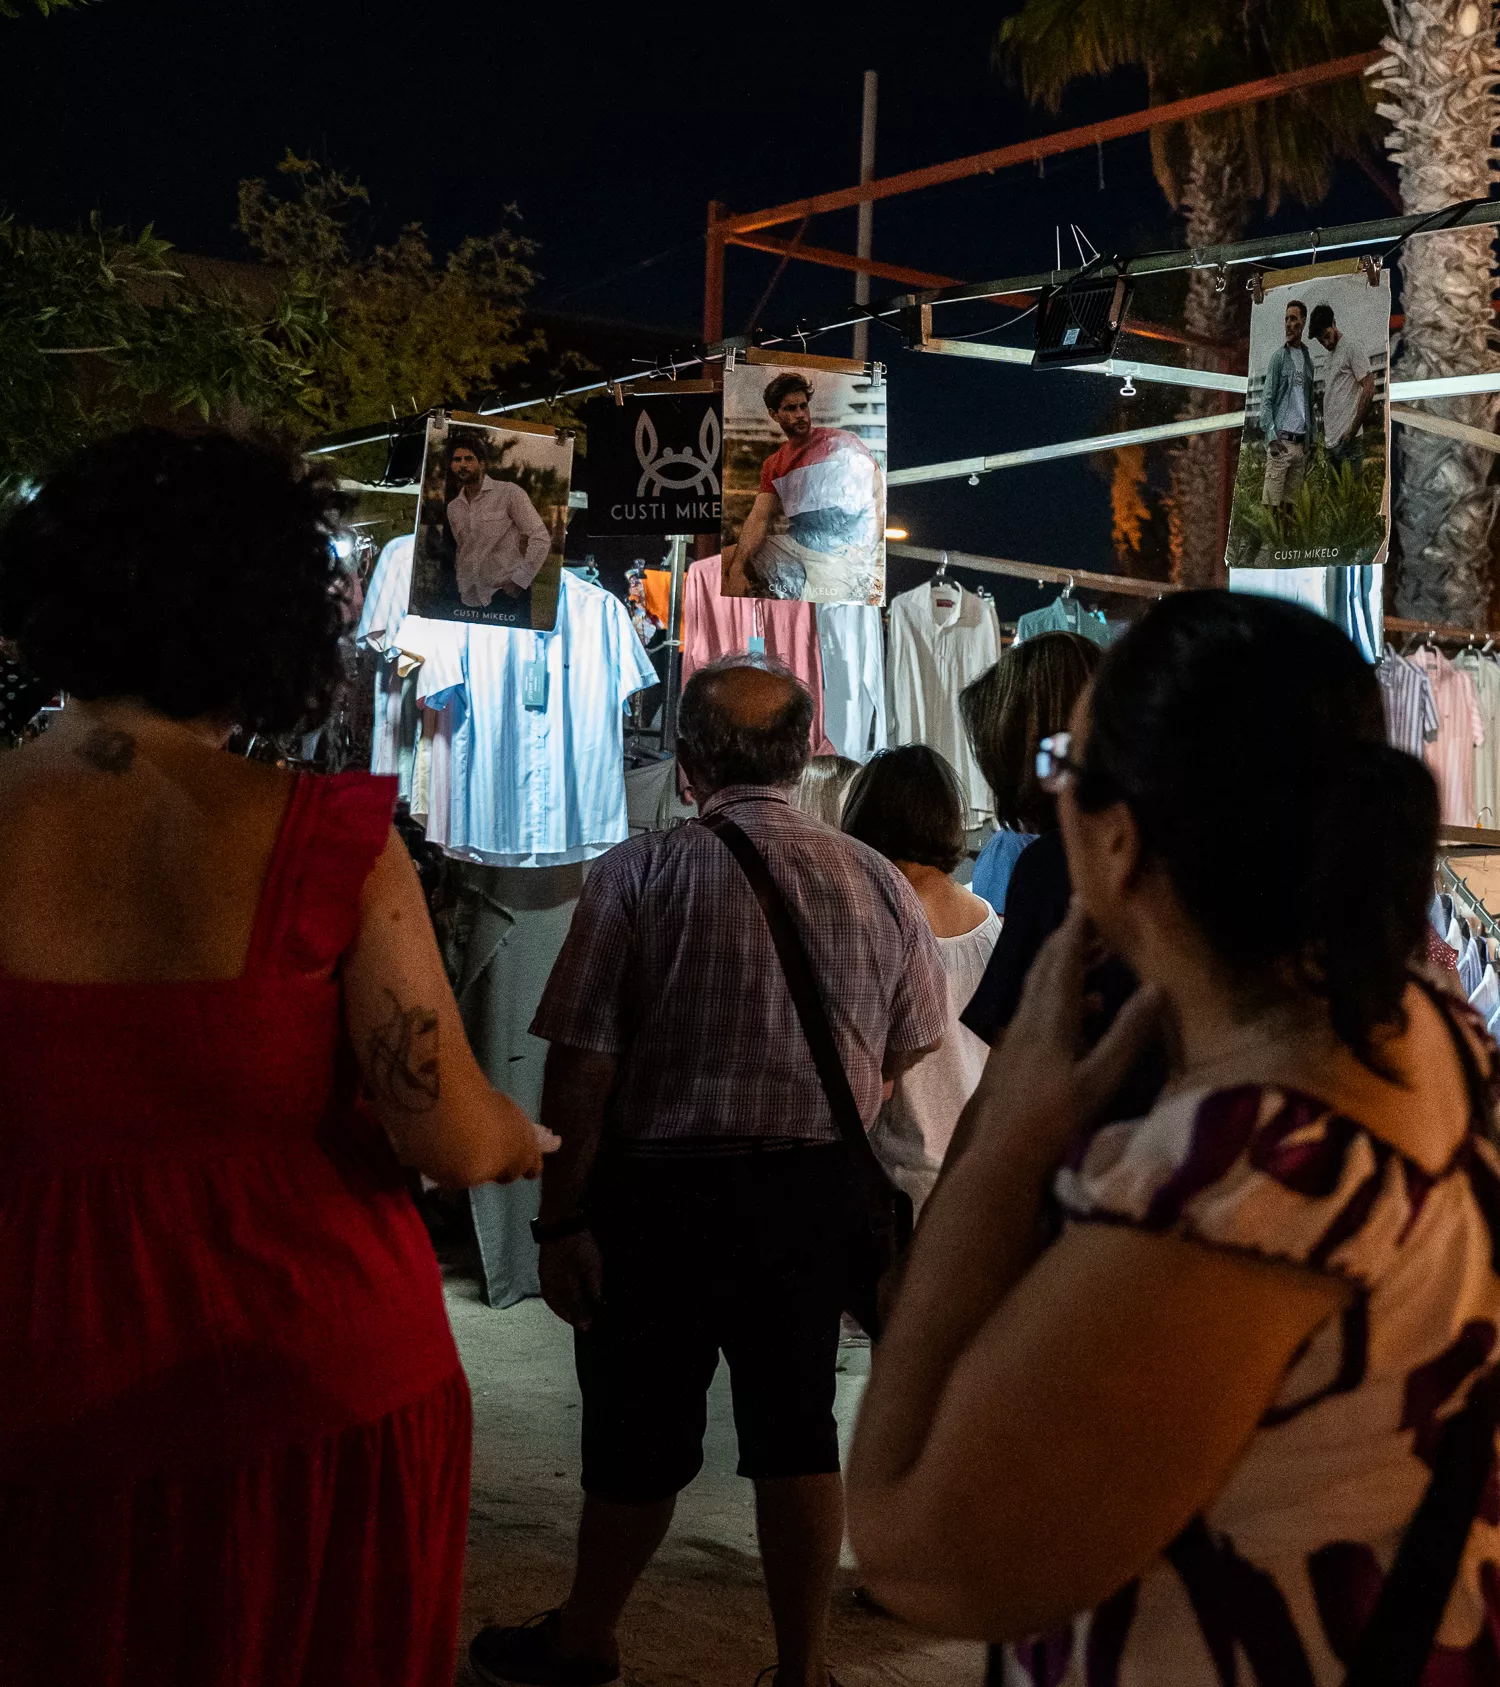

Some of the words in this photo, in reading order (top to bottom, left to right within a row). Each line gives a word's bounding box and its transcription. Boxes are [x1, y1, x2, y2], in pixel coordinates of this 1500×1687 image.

[611, 503, 666, 520] CUSTI
[676, 502, 721, 519] MIKE
[1274, 550, 1301, 560] CUSTI
[1304, 547, 1339, 559] MIKELO
[768, 583, 797, 594] CUSTI
[453, 609, 479, 618] CUSTI
[482, 612, 516, 622] MIKELO
